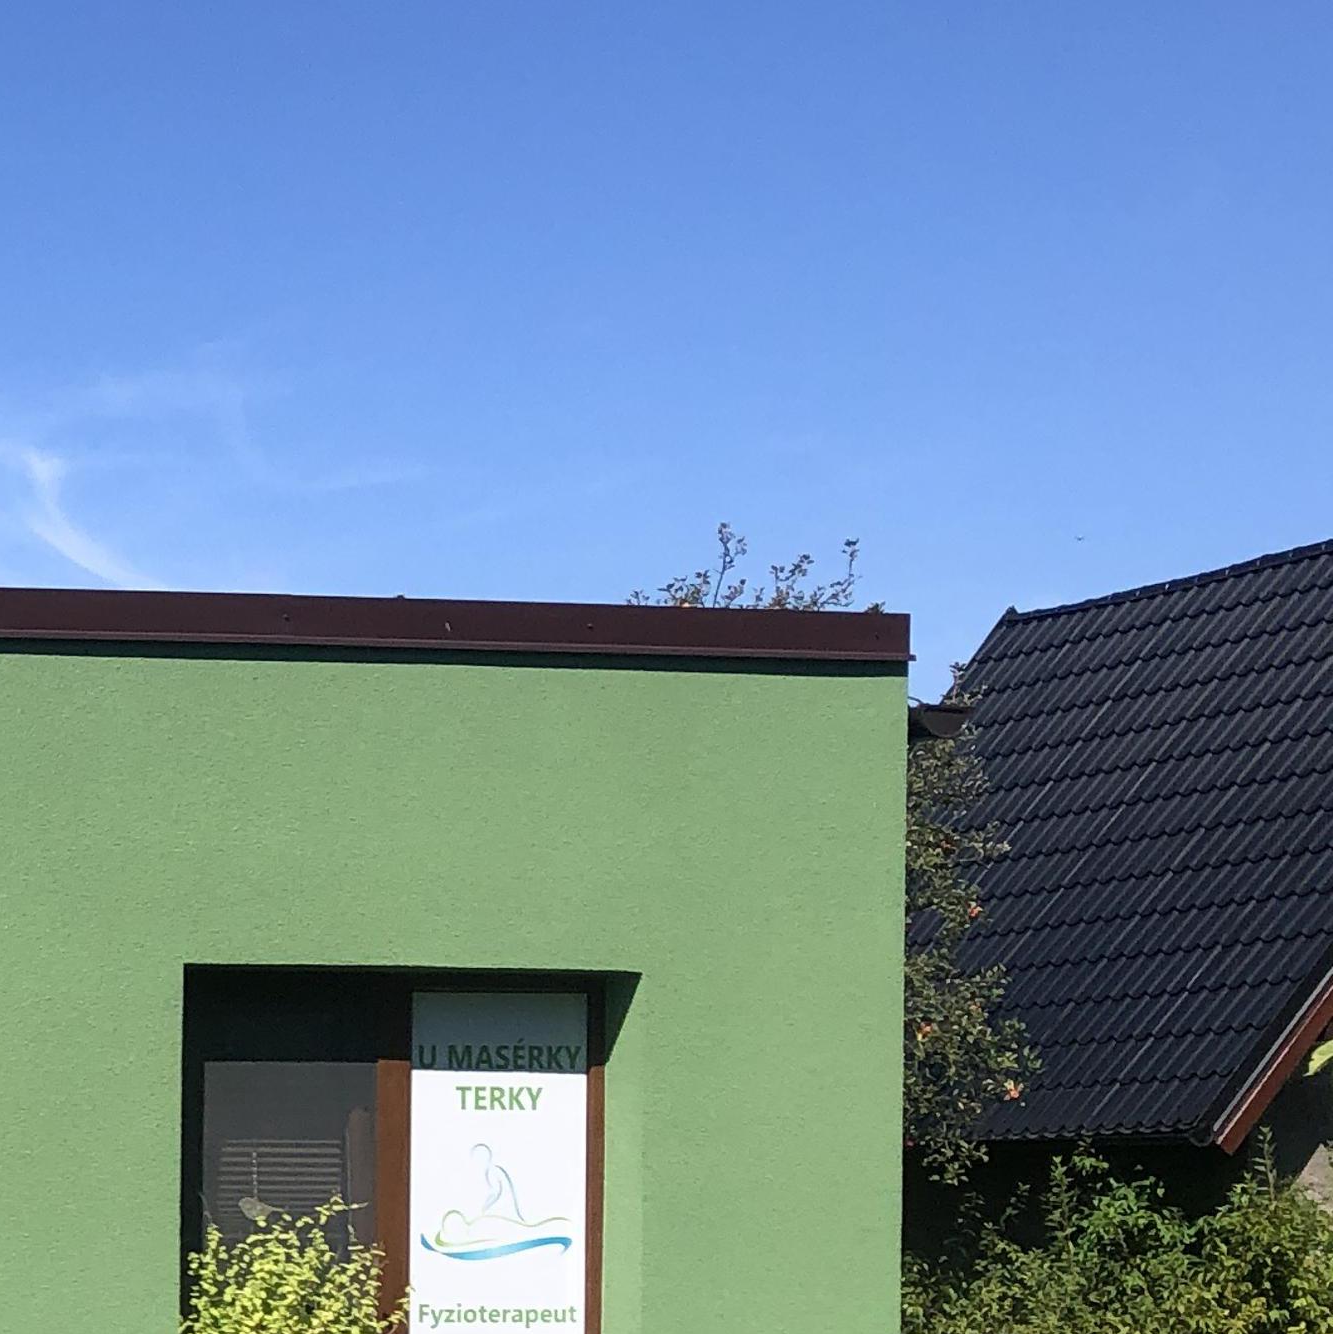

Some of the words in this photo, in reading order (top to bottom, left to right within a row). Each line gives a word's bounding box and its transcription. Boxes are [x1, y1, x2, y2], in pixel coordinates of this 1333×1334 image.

[419, 1045, 436, 1069] U
[448, 1039, 581, 1070] MASÉRKY
[456, 1086, 543, 1111] TERKY
[419, 1303, 577, 1328] Fyzioterapeut
